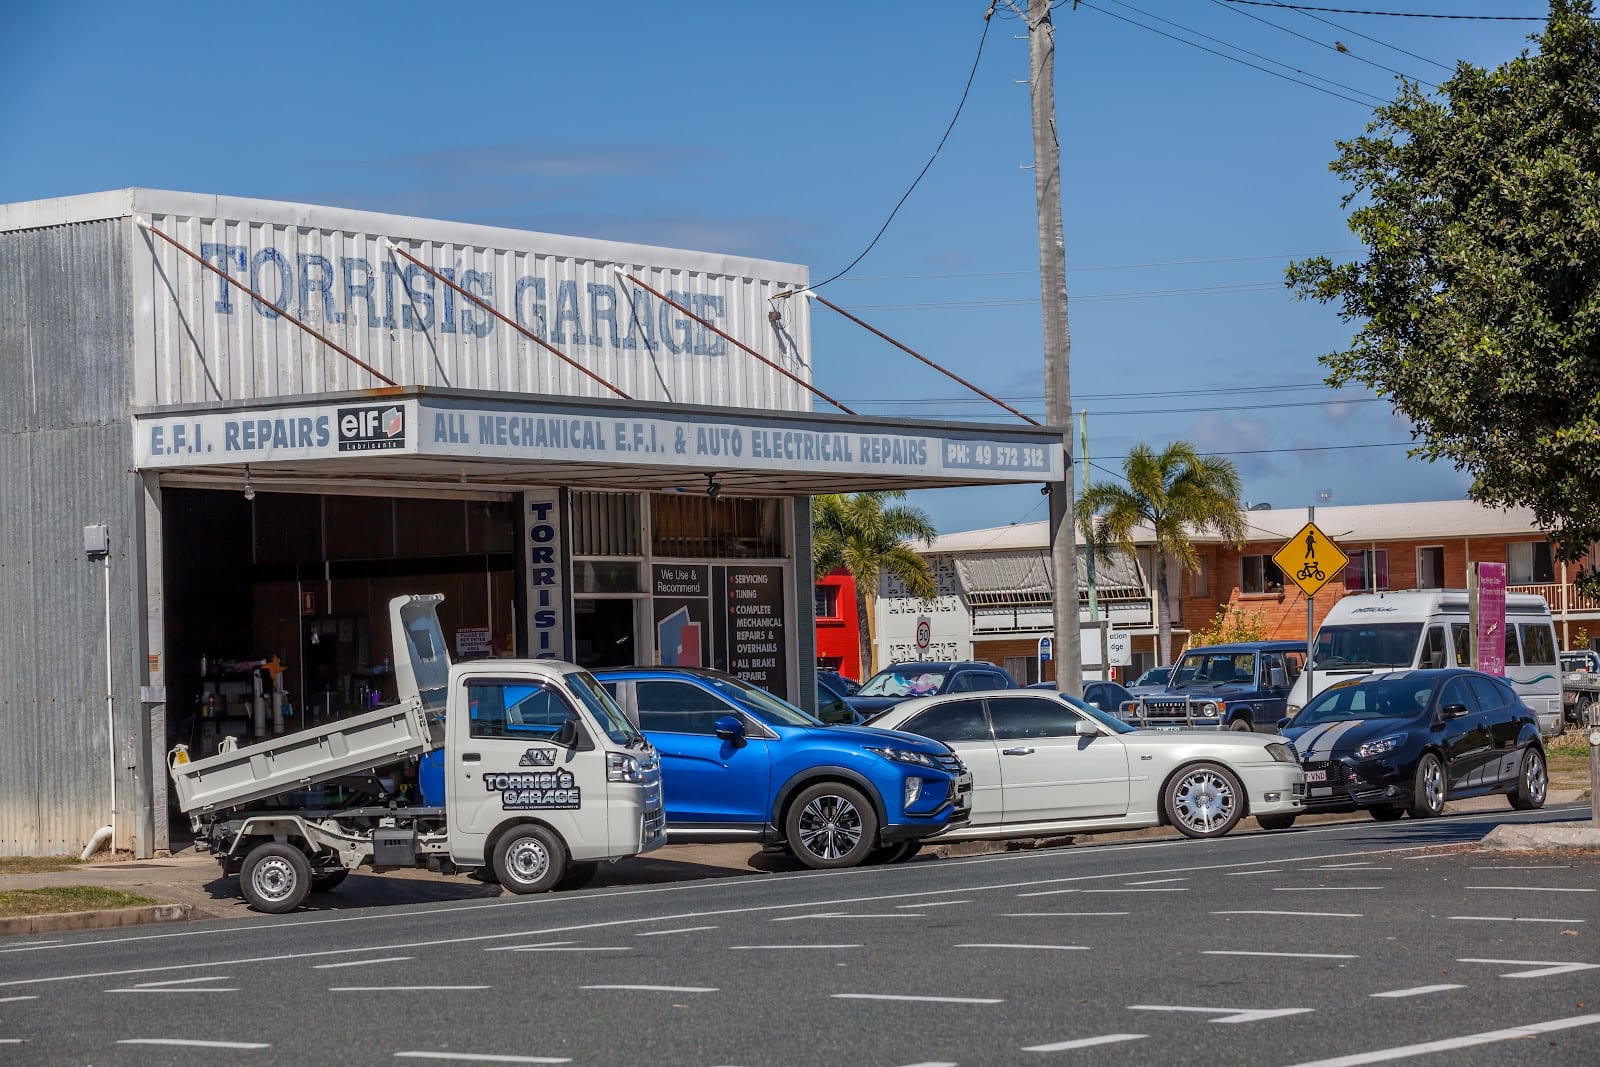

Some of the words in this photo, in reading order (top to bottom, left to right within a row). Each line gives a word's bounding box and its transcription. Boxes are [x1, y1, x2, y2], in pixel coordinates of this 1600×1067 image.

[200, 241, 494, 339] TORRISI'S
[515, 275, 726, 357] GARAGE
[340, 410, 379, 438] elf
[150, 422, 213, 456] E.F.I.
[224, 415, 331, 452] REPAIRS
[434, 412, 470, 444] ALL
[479, 415, 606, 451] MECHANICAL
[615, 422, 665, 453] E.F.I.
[674, 425, 687, 455] &
[696, 427, 742, 458] AUTO
[752, 430, 853, 463] ELECTRICAL
[860, 437, 928, 466] REPAIRS
[947, 443, 970, 464] PH:
[975, 445, 992, 465] 49
[997, 446, 1018, 466] 572
[1023, 447, 1044, 467] 312
[660, 569, 674, 580] We
[675, 569, 689, 580] Use
[691, 569, 697, 580] &
[735, 574, 768, 584] SERVICING
[657, 581, 700, 593] Recommend
[735, 589, 758, 598] TUNING
[735, 605, 771, 614] COMPLETE
[736, 618, 783, 628] MECHANICAL
[736, 631, 765, 640] REPAIRS
[768, 630, 774, 640] &
[919, 629, 928, 641] 50
[737, 643, 777, 653] OVERHAULS
[737, 659, 750, 668] ALL
[752, 658, 776, 668] BRAKE
[737, 671, 767, 680] REPAIRS
[484, 769, 573, 790] TORRISI'S
[503, 789, 580, 804] GARAGE
